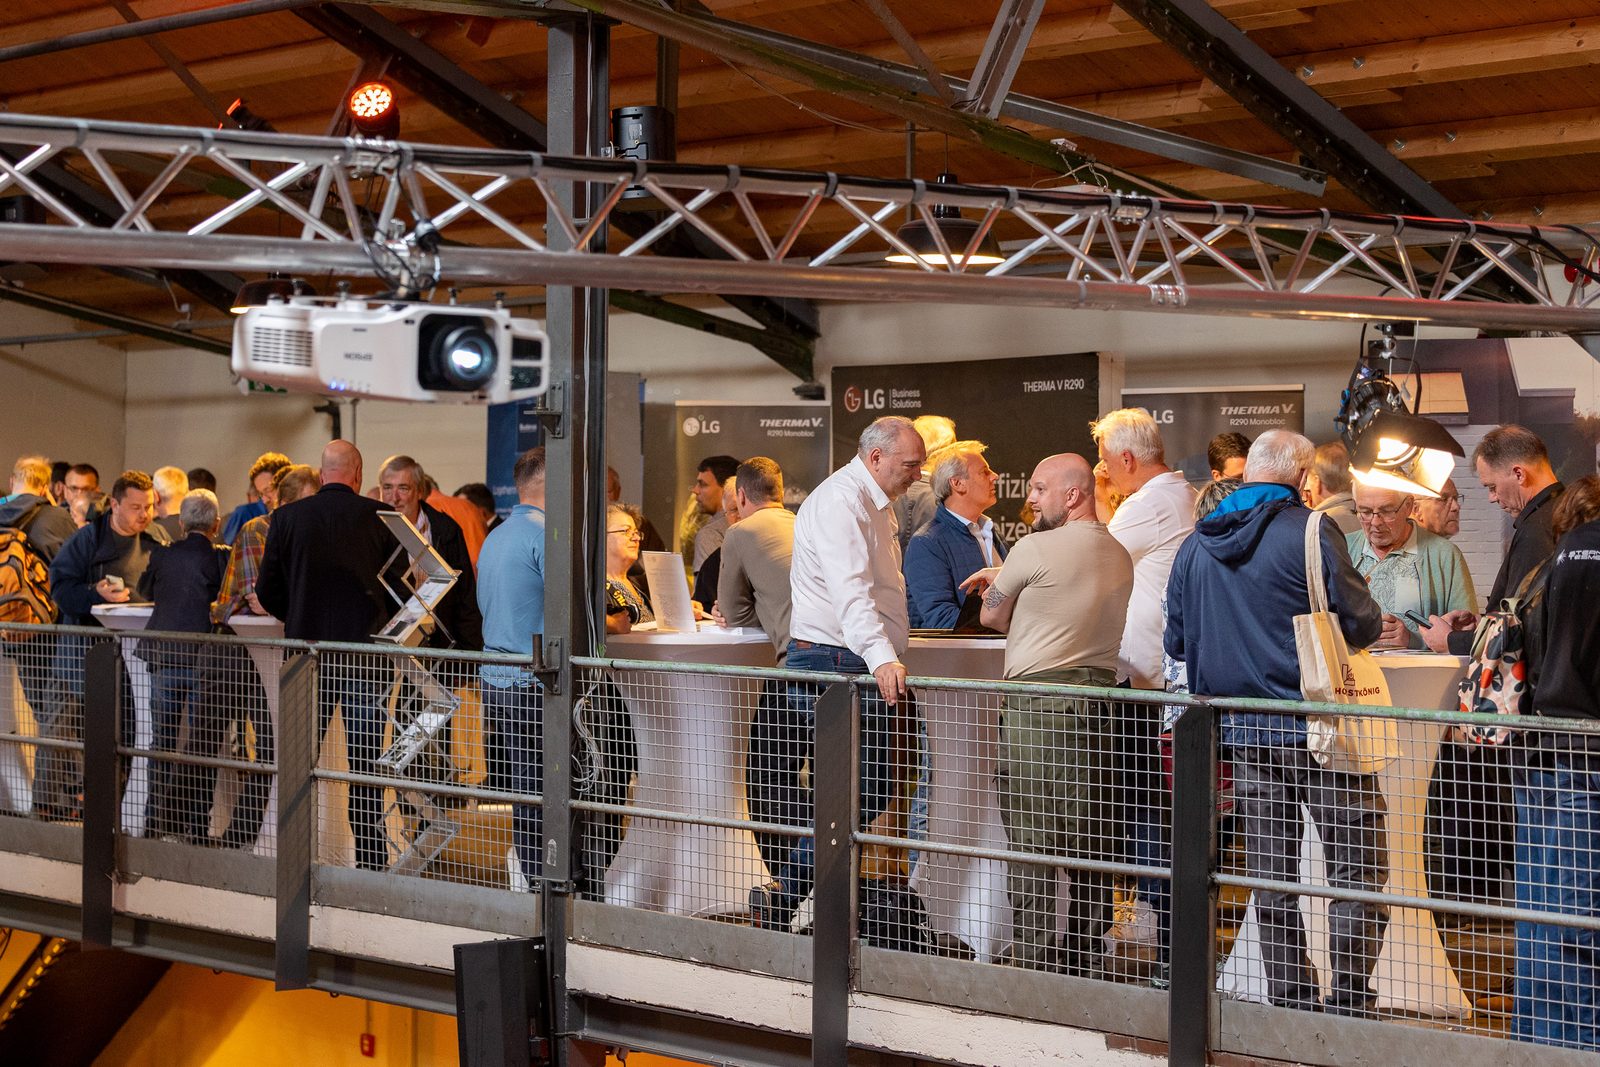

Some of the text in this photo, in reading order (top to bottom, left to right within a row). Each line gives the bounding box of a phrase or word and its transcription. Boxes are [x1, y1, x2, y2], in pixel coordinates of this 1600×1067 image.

[1023, 379, 1085, 392] THERMA V R290
[864, 389, 885, 409] LG
[892, 389, 920, 398] Business
[892, 399, 921, 408] Solutions
[1220, 406, 1280, 415] THERMA
[1153, 410, 1174, 424] LG
[702, 420, 720, 433] LG
[760, 419, 810, 427] THERMA
